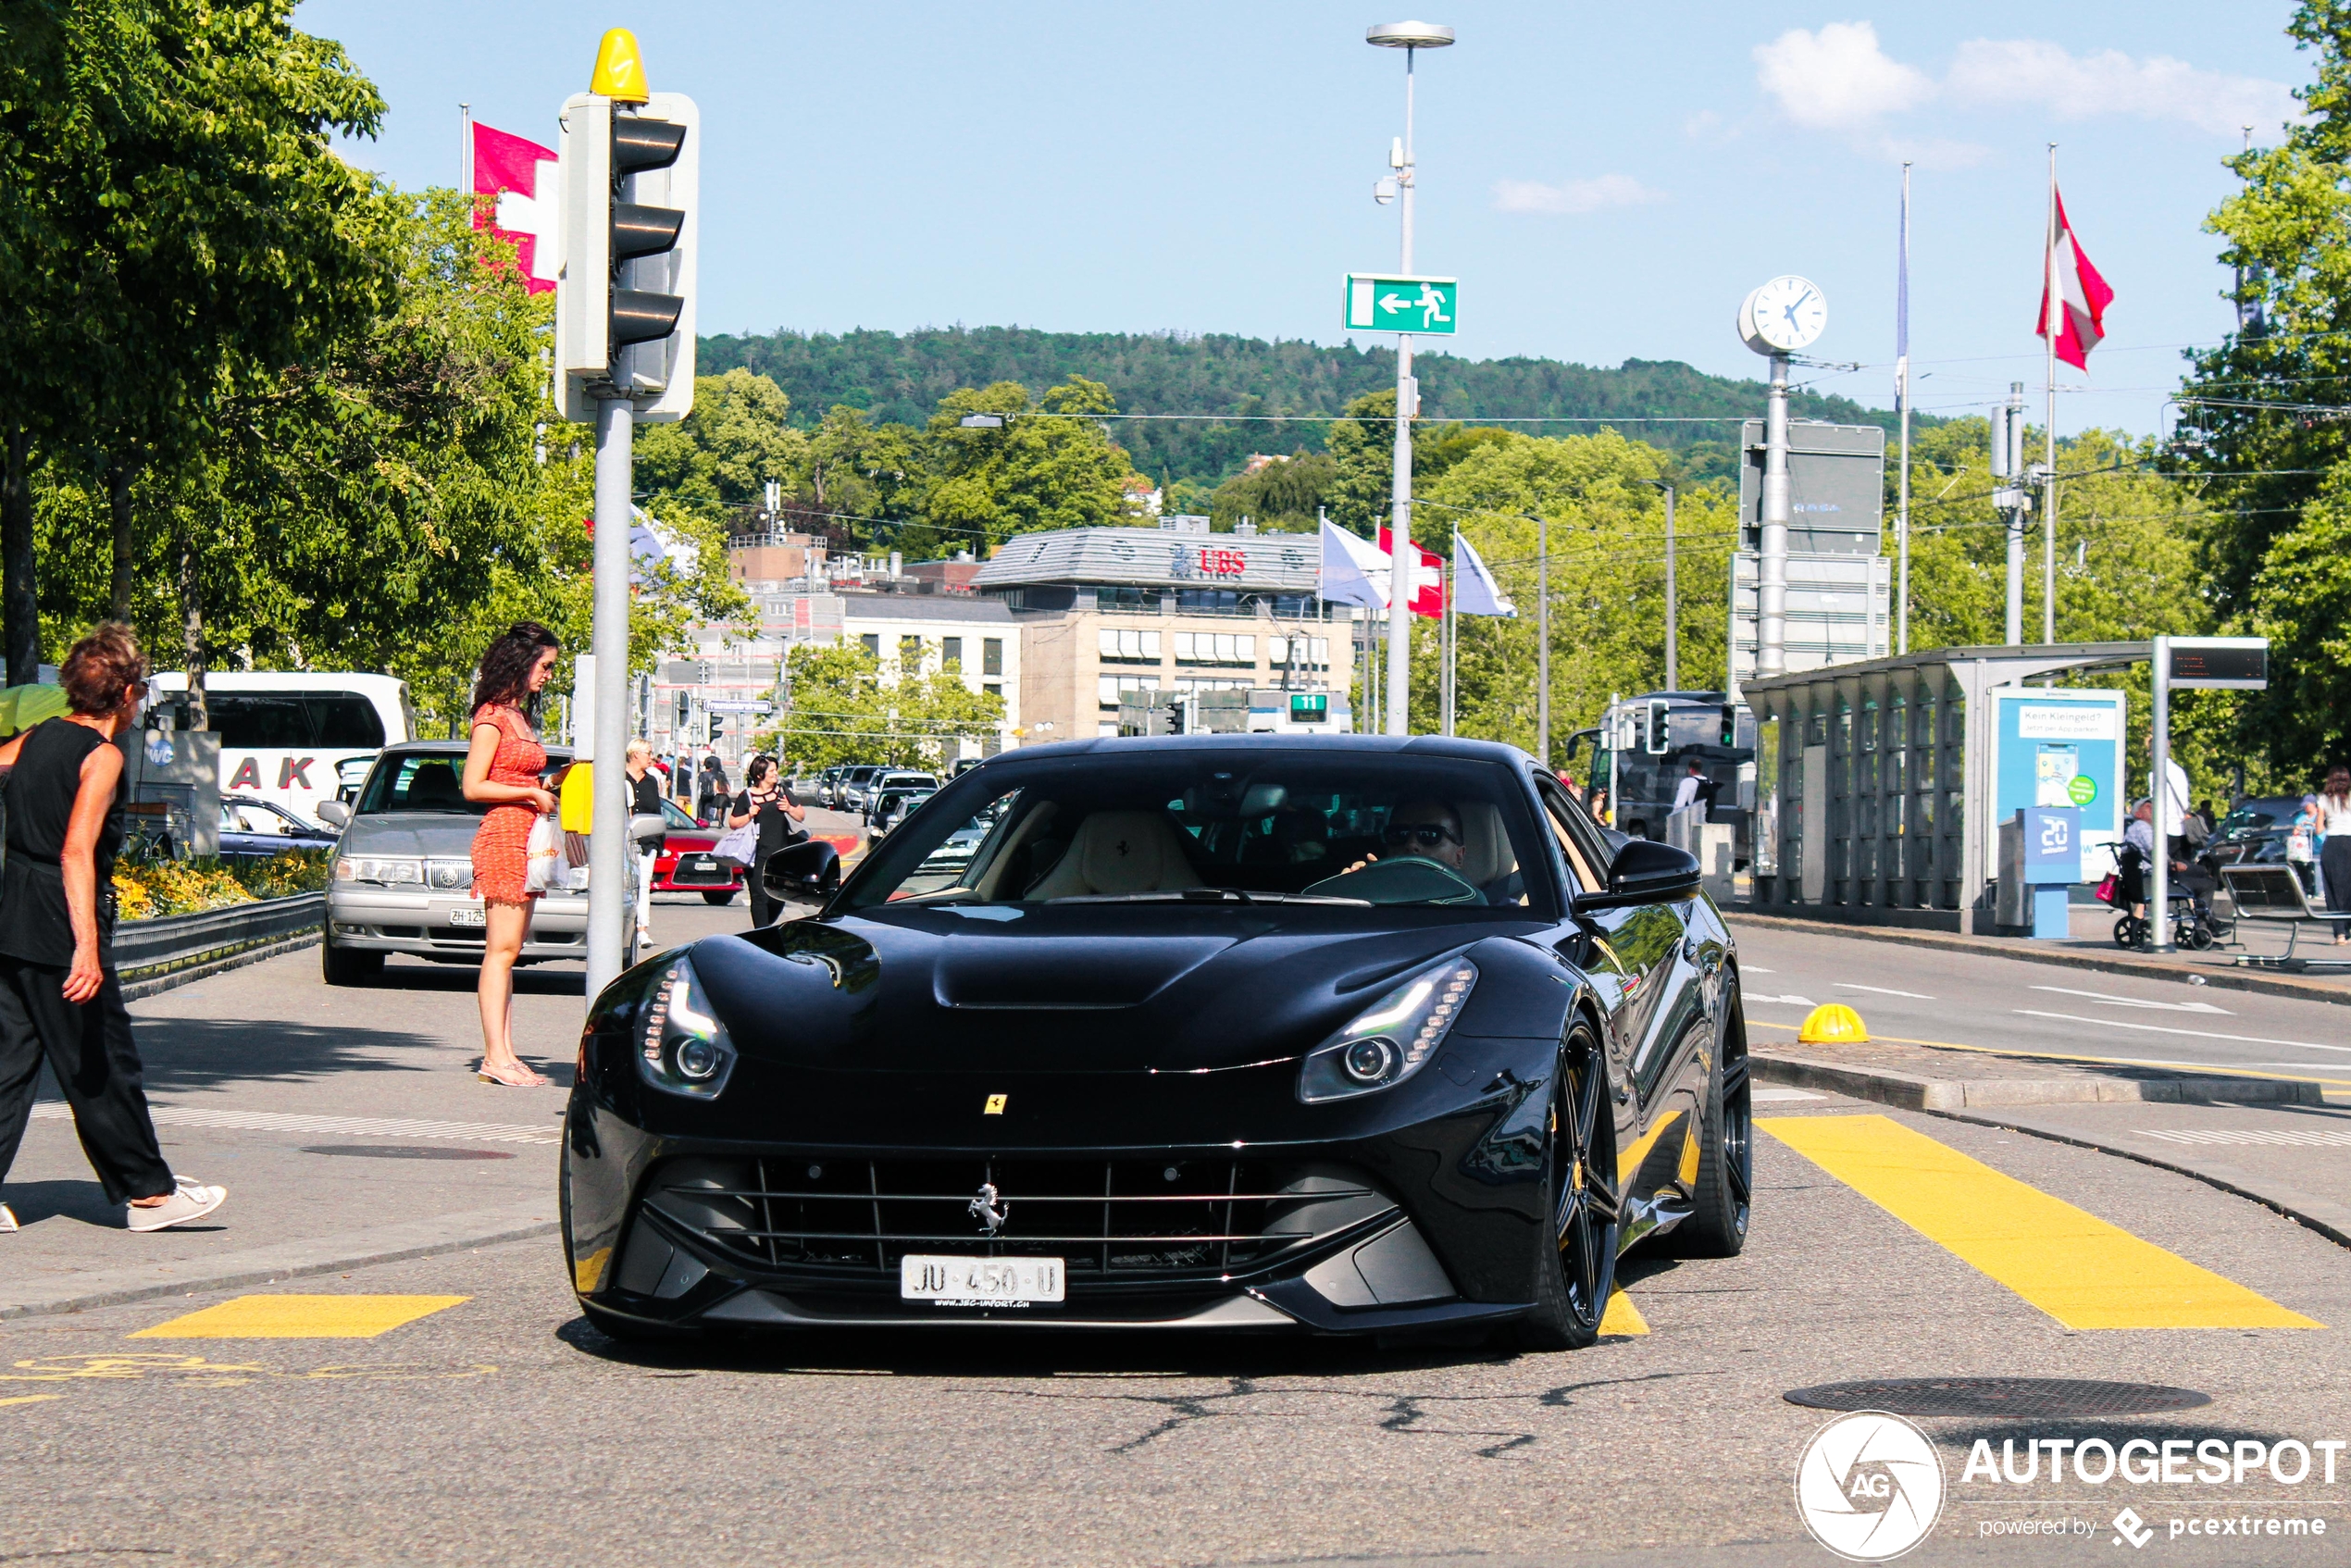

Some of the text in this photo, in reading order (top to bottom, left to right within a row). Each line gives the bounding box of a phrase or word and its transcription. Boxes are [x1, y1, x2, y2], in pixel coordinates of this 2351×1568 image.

[1200, 550, 1246, 574] UBS
[1300, 695, 1316, 710] 11
[2024, 712, 2102, 723] Kein Kleingeld?
[149, 749, 174, 764] WC
[2041, 818, 2068, 847] 20
[542, 848, 560, 859] city
[2041, 846, 2069, 855] minuten
[913, 1263, 1055, 1296] JU 450 U
